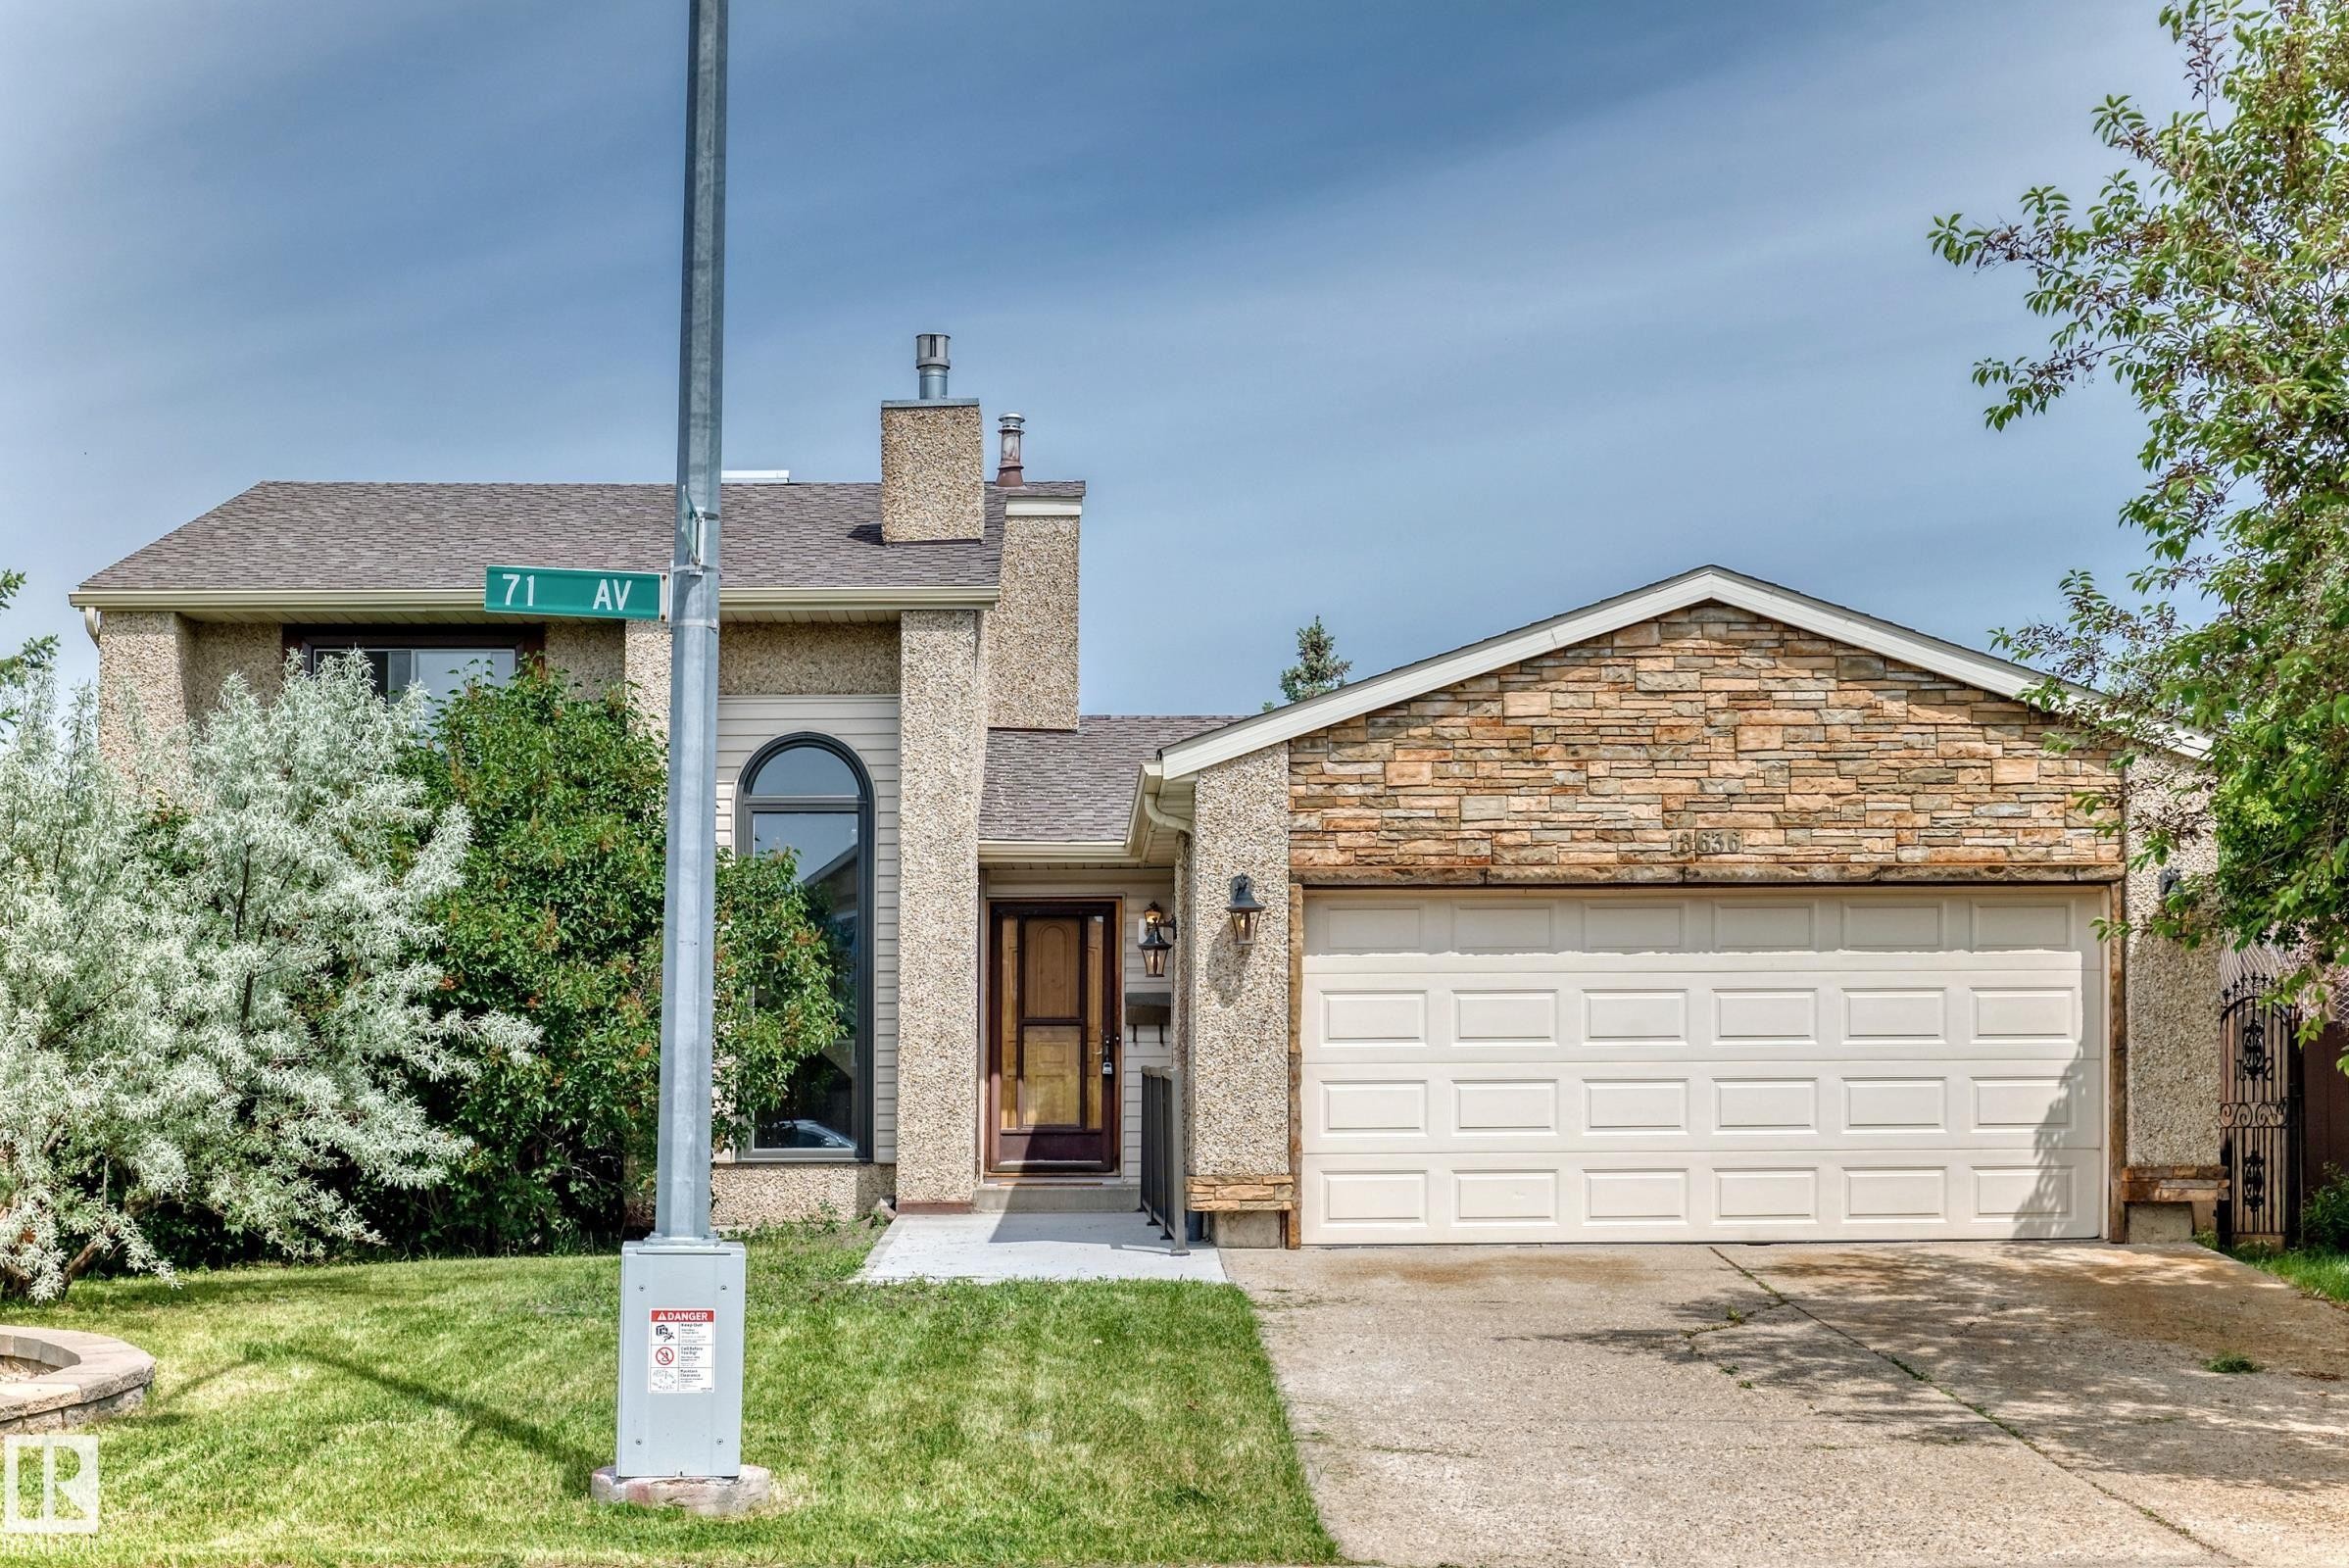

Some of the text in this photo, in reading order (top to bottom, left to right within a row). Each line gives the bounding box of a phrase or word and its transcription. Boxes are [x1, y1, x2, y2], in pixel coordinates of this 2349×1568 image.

[503, 573, 632, 612] 71 AV
[1669, 831, 1741, 855] 18636
[667, 1311, 709, 1321] DANGER
